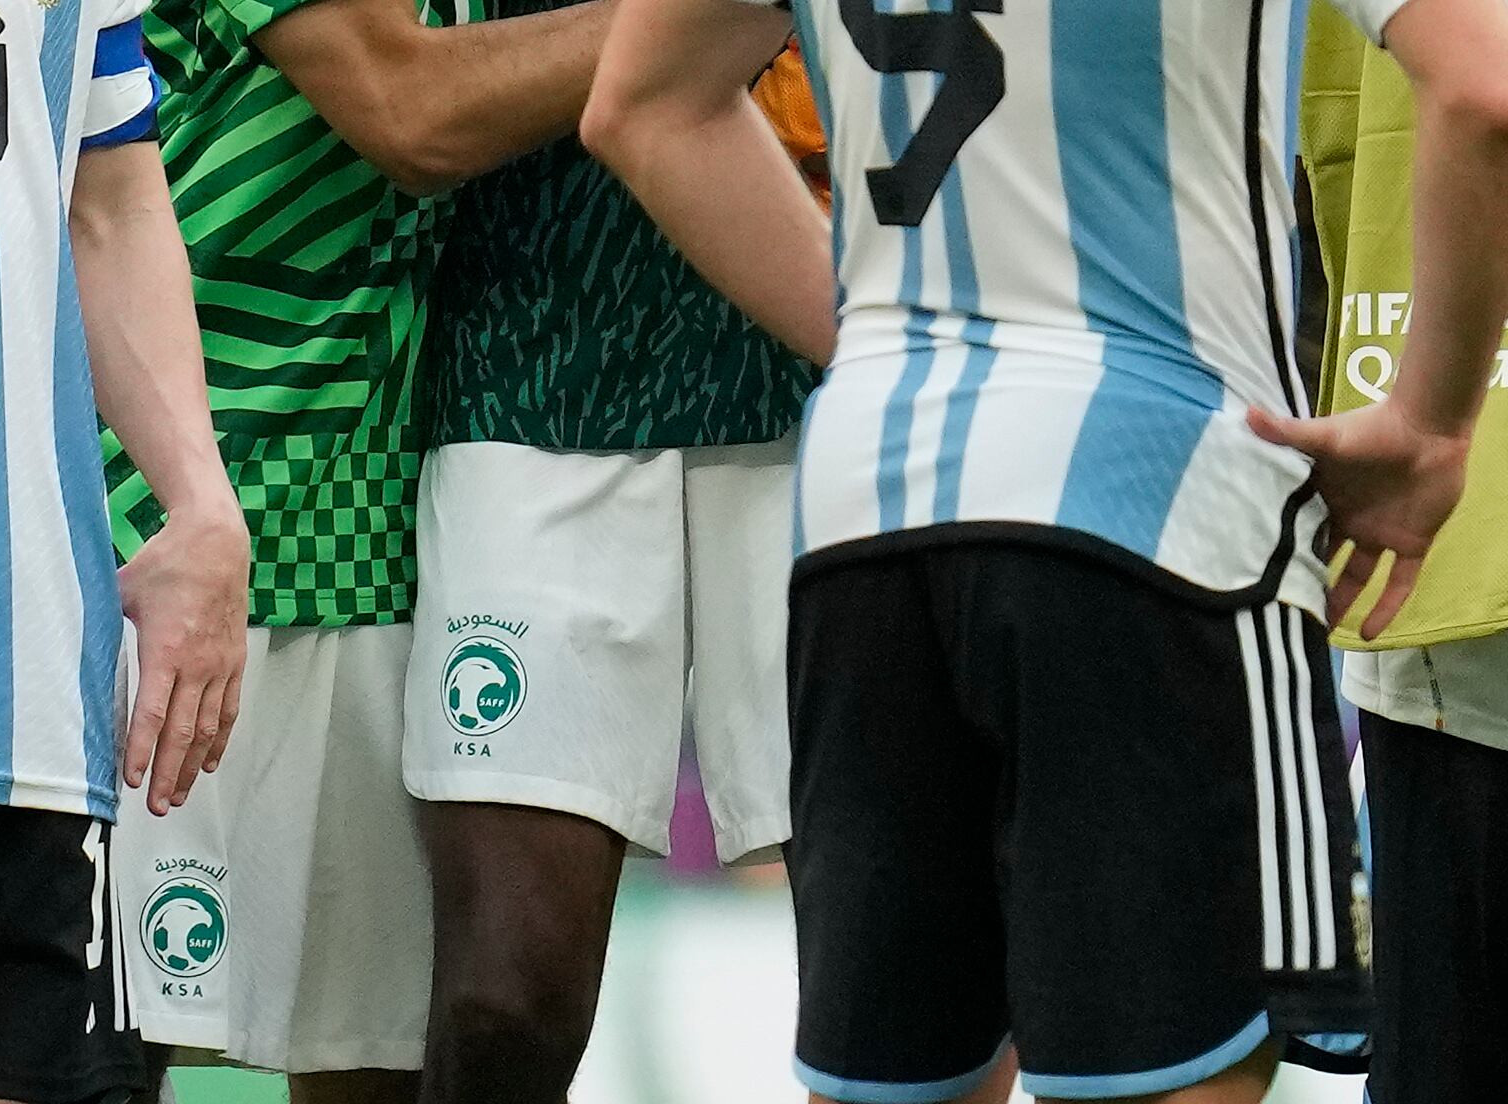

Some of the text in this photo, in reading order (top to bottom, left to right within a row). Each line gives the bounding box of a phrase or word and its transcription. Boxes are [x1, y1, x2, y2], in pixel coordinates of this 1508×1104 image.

[446, 615, 530, 639] السعودية
[478, 697, 505, 708] SAFF
[155, 857, 228, 882] السعودية
[189, 938, 213, 949] SAFF
